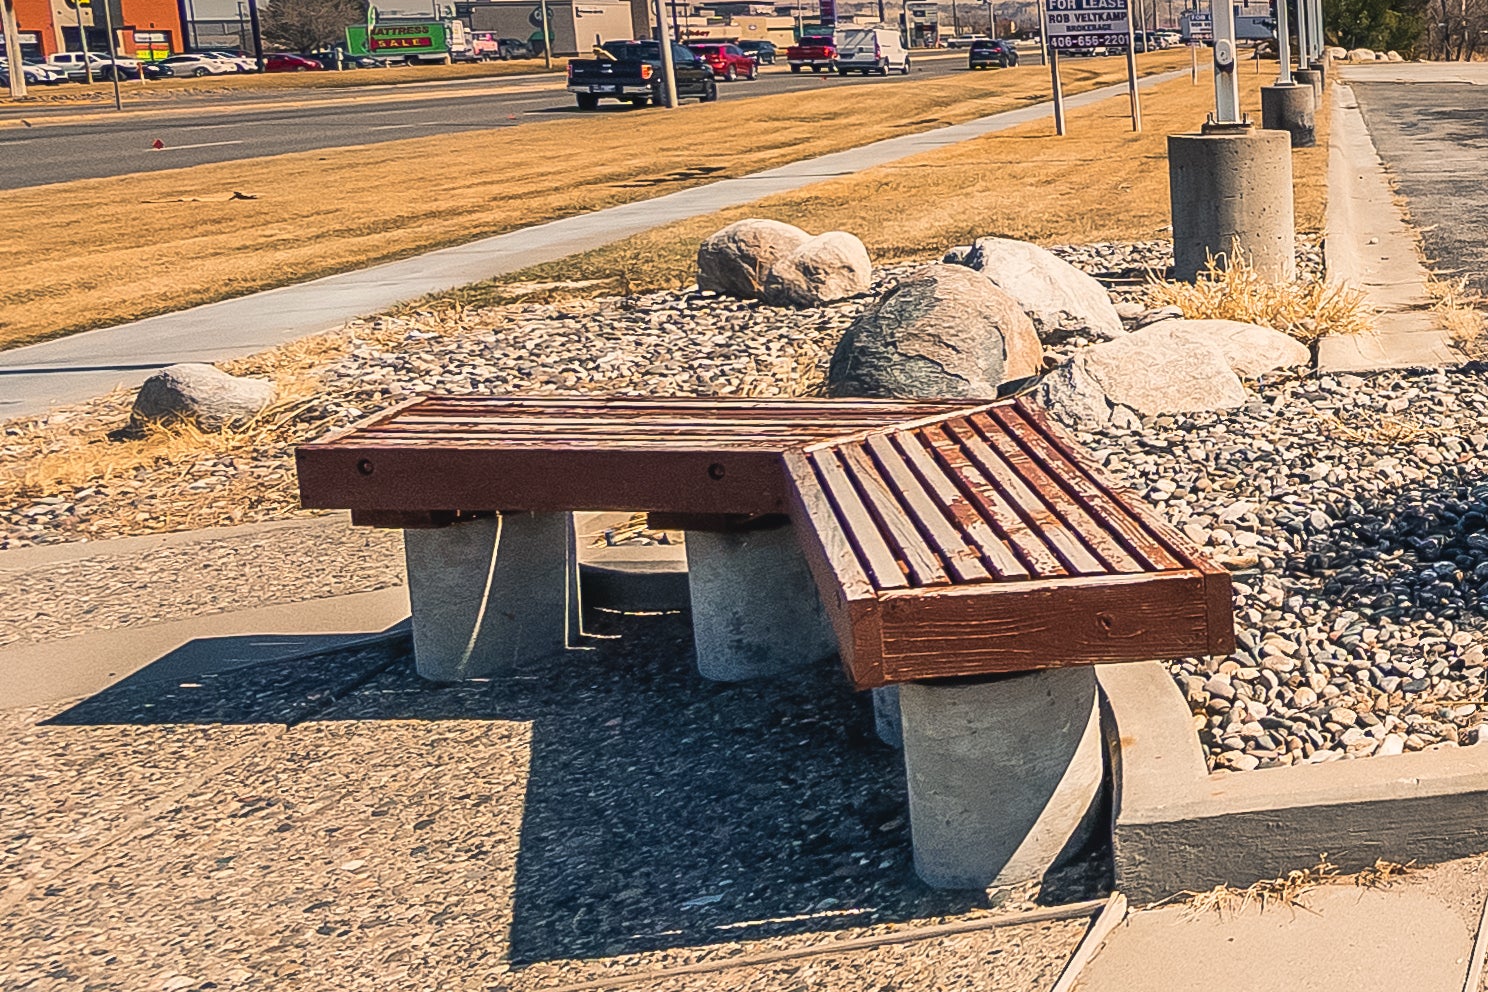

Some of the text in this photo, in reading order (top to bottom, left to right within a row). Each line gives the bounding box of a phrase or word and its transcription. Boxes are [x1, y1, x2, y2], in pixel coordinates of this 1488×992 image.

[1048, 11, 1127, 23] ROB VELTKAMP
[378, 38, 422, 48] SALE
